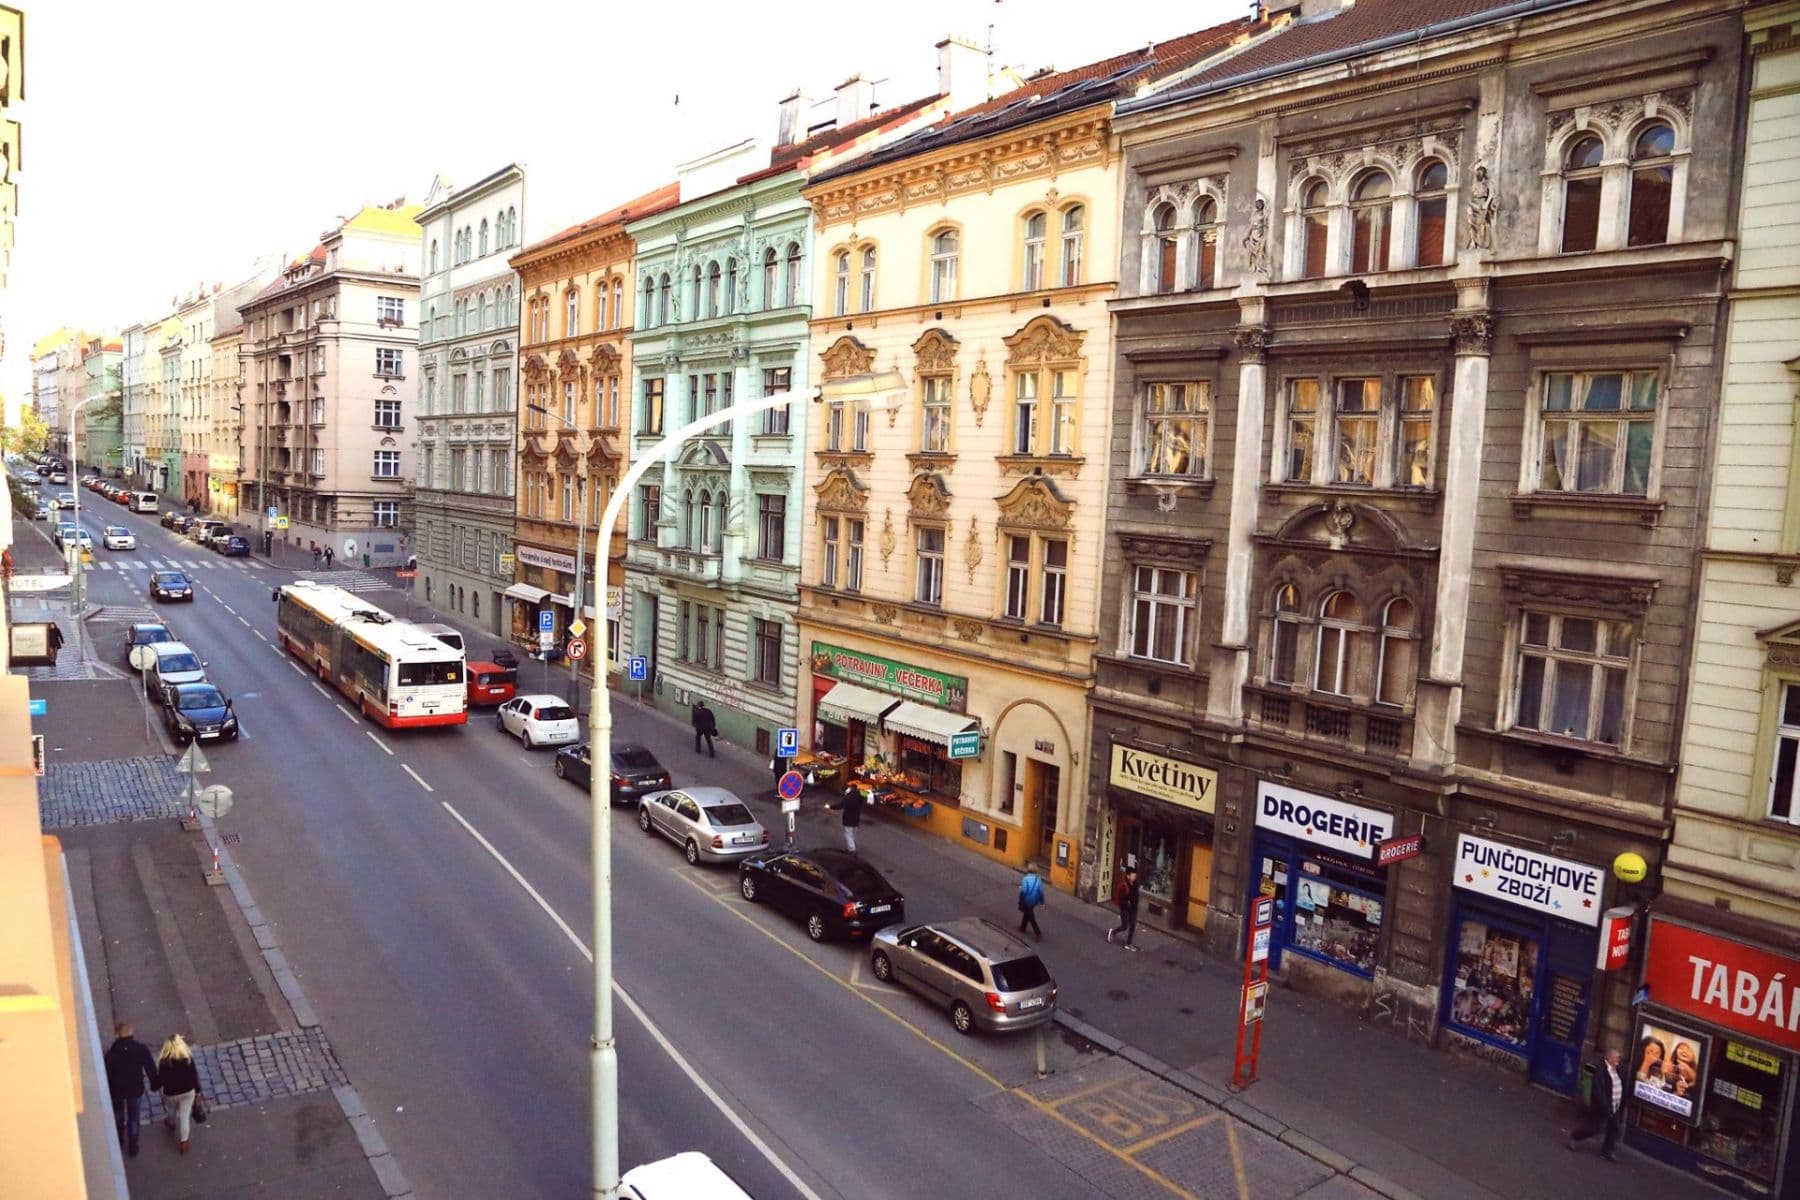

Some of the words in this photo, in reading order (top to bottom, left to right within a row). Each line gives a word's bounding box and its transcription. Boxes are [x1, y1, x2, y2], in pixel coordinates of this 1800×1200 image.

[835, 654, 888, 679] POTRAVINY
[895, 668, 944, 695] VEČERKA
[1121, 749, 1212, 801] Květiny
[1263, 795, 1384, 846] DROGERIE
[1380, 840, 1420, 861] DROGERIE
[1462, 841, 1598, 896] PUNČOCHOVÉ
[1497, 875, 1552, 905] ZBOŽÍ
